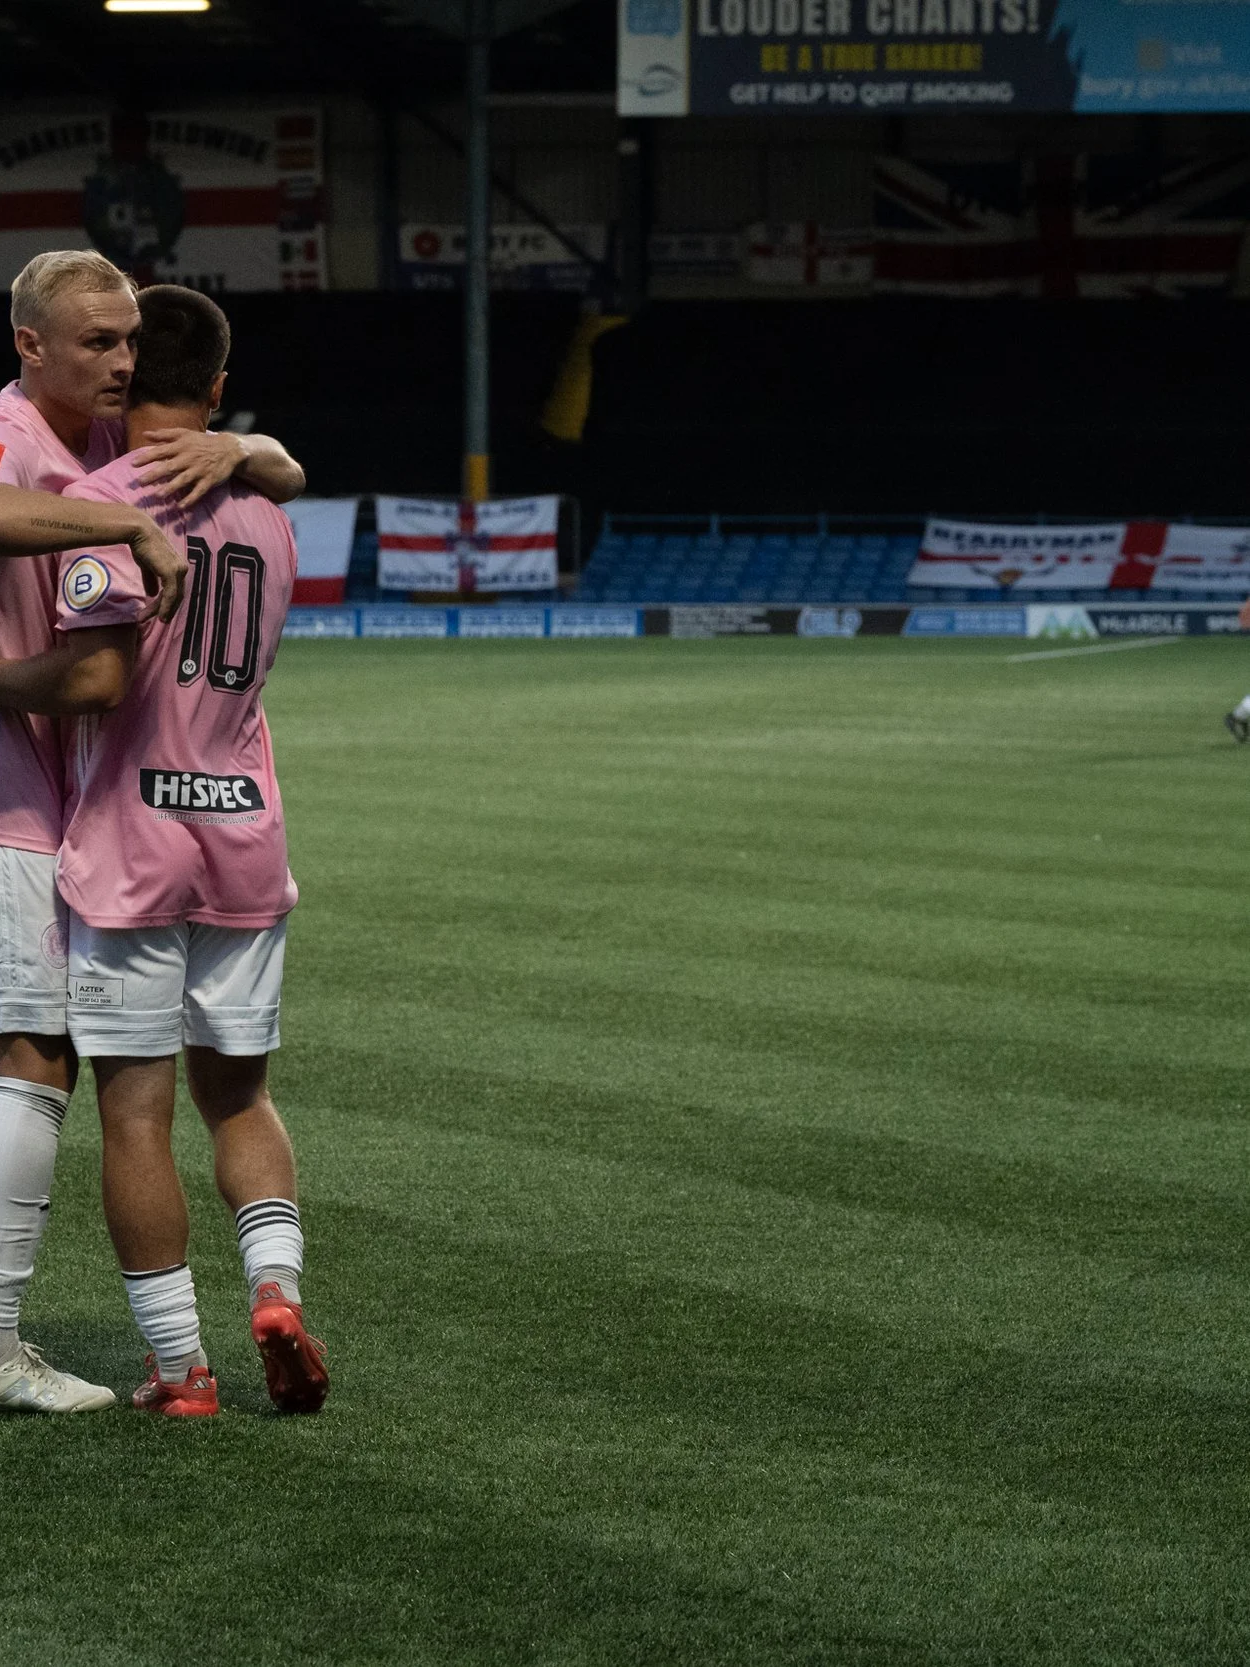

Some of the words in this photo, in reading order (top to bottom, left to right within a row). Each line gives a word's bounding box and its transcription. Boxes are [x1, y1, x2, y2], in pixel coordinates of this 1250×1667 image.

[698, 0, 851, 36] LOUDER
[867, 0, 1039, 36] CHANTS!
[760, 43, 788, 72] BE
[797, 43, 813, 71] A
[822, 43, 877, 71] TRUE
[729, 82, 770, 104] GET
[773, 82, 824, 104] HELP
[827, 82, 856, 104] TO
[859, 82, 908, 107] QUIT
[911, 81, 1015, 103] SMOKING
[75, 573, 93, 595] B
[154, 773, 252, 808] HiSPEC
[79, 985, 105, 993] AZTEK
